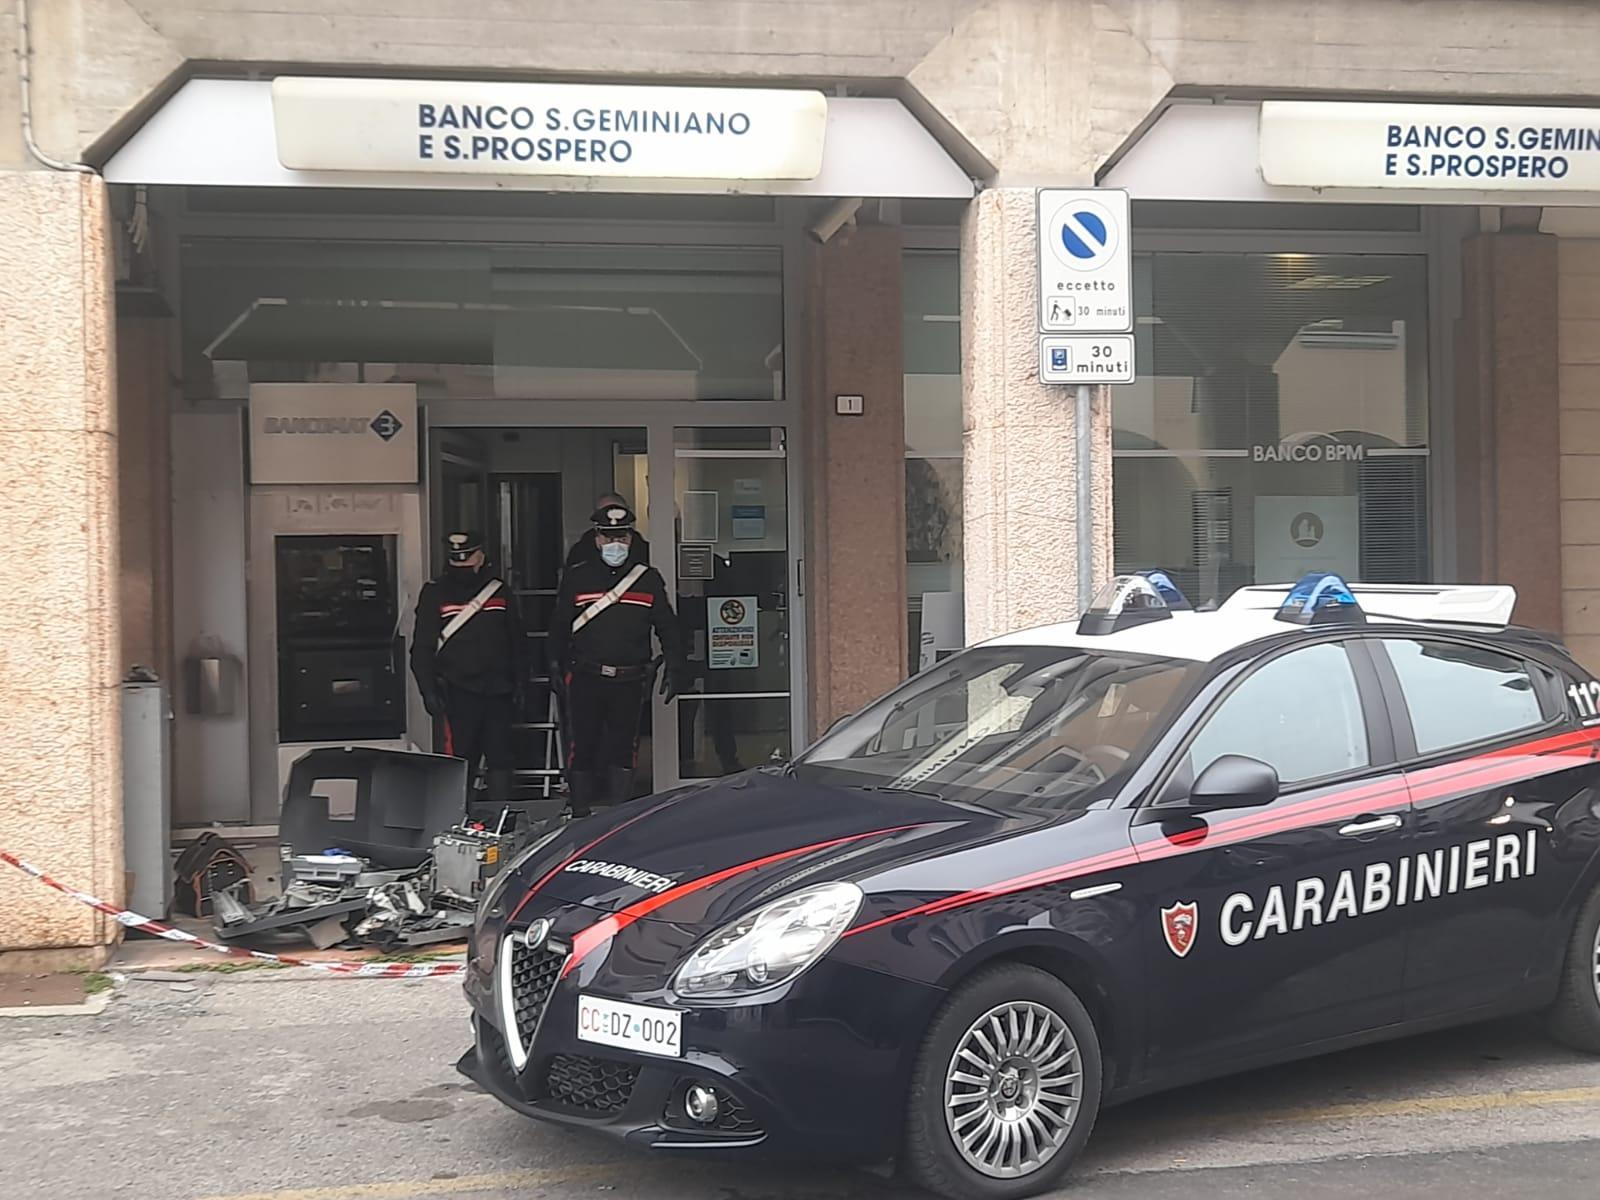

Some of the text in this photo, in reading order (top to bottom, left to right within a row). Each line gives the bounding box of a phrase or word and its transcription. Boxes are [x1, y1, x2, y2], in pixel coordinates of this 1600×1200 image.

[418, 103, 751, 136] BANCO S.GEMINIANO
[1387, 125, 1486, 149] BANCO
[418, 136, 633, 163] E S.PROSPERO
[1385, 154, 1569, 179] E S.PROSPERO
[1057, 280, 1115, 291] eccetto
[1078, 305, 1126, 316] 30 minuti
[1092, 345, 1112, 358] 30
[1076, 361, 1128, 373] minuti
[1253, 444, 1363, 462] BANCO BPM
[564, 860, 677, 893] CARABINIERI
[1219, 829, 1537, 947] CARABINIERI
[581, 1007, 677, 1046] CC DZ 002
